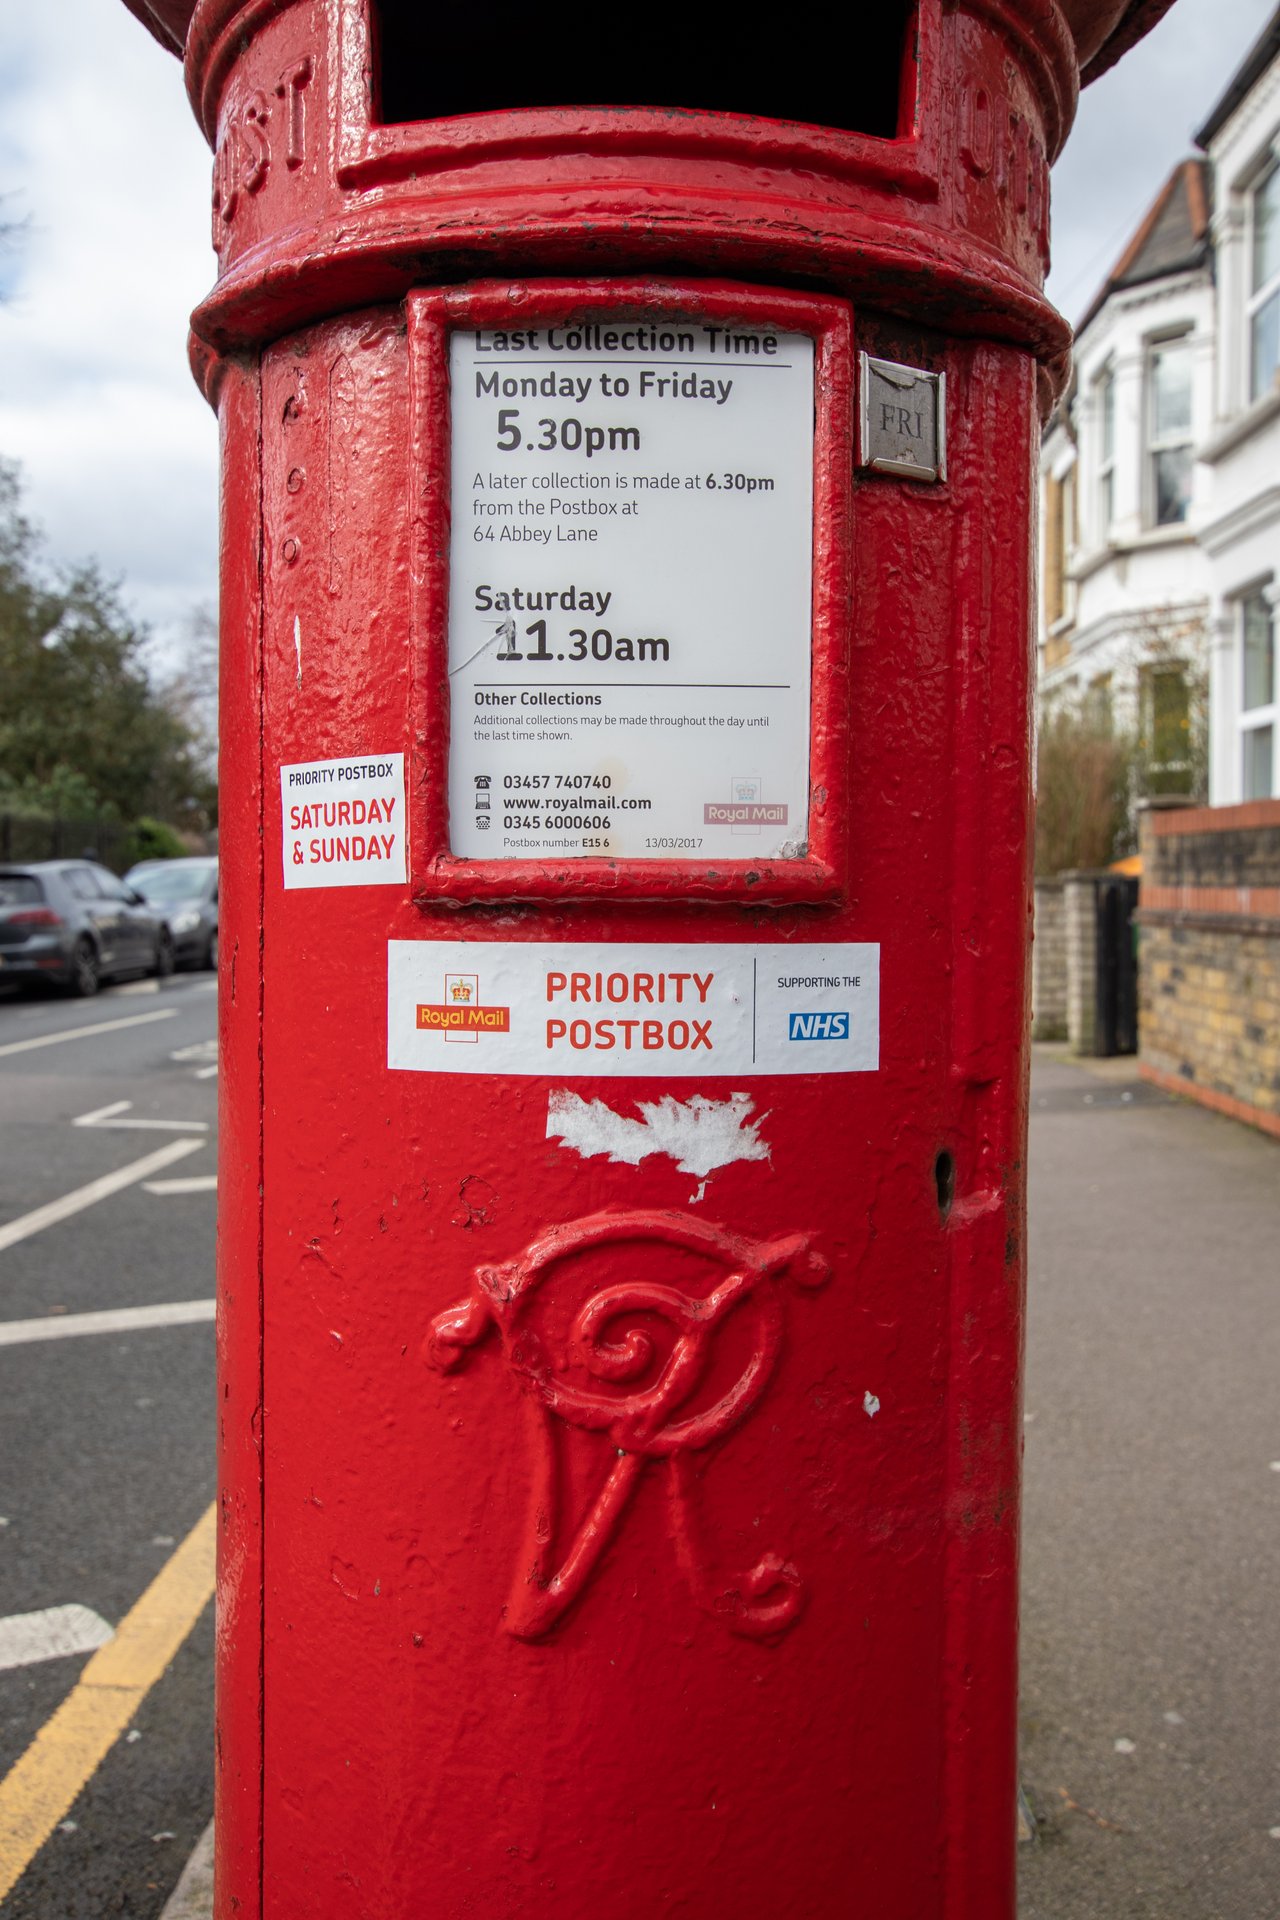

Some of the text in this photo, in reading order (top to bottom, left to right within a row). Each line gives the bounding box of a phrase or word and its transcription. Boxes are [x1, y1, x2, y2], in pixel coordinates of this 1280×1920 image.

[475, 324, 777, 355] Last Collection Time
[476, 371, 733, 404] Monday to Friday
[880, 403, 923, 439] FRI
[497, 409, 641, 457] 5.30pm
[472, 472, 775, 494] A later collection is made at 6.30pm
[473, 498, 638, 516] from the Postbox at
[473, 525, 598, 545] 64 Abbey Lane
[475, 585, 612, 617] Saturday
[495, 619, 670, 661] 11.30am
[474, 692, 602, 706] Other Collections
[473, 715, 770, 728] Additional collections may be made throughout the day until
[474, 730, 573, 741] the last time shown.
[290, 763, 394, 787] PRIORITY POSTBOX
[503, 775, 612, 789] 03457 740740
[290, 797, 395, 831] SATURDAY
[503, 796, 652, 812] www.royalmail.com
[709, 807, 784, 822] Royal Mail
[503, 816, 611, 829] 0345 6000606
[293, 834, 395, 865] & SUNDAY
[504, 838, 610, 848] Postbox number E15 6
[645, 837, 703, 849] 13/03/2017
[546, 972, 714, 1004] PRIORITY
[777, 976, 861, 989] SUPPORTING THE
[421, 1009, 505, 1028] Royal Mail
[791, 1014, 848, 1039] NHS
[546, 1019, 713, 1051] POSTBOX
